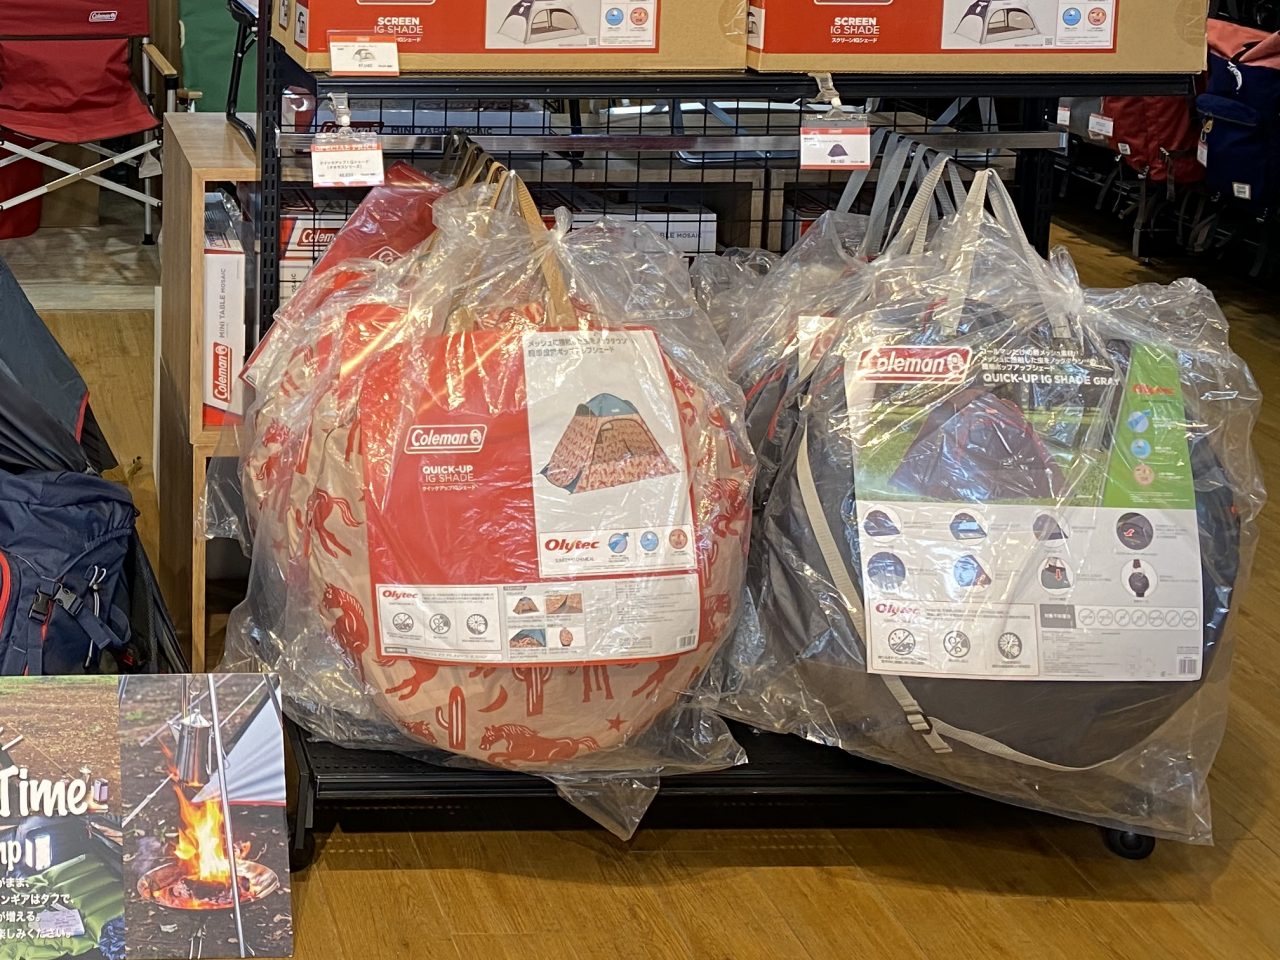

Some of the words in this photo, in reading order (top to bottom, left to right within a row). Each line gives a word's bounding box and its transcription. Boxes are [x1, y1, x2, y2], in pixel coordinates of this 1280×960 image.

[377, 17, 420, 25] SCREEN
[834, 17, 877, 26] SCREEN
[374, 26, 387, 34] IG
[388, 26, 424, 34] SHADE
[831, 26, 841, 34] IG
[844, 26, 880, 35] SHADE
[302, 229, 336, 243] Colem
[866, 352, 945, 375] Coleman
[216, 351, 228, 401] Coleman
[982, 373, 1039, 383] QUICK-UP
[1041, 375, 1052, 384] IG
[1054, 375, 1091, 385] SHADE
[1093, 376, 1120, 386] GRAY
[412, 428, 469, 446] Coleman
[422, 465, 474, 475] QUICK-UP
[425, 474, 437, 483] IG
[439, 473, 474, 482] SHADE
[544, 538, 601, 554] Olytec
[382, 590, 419, 600] Olytec
